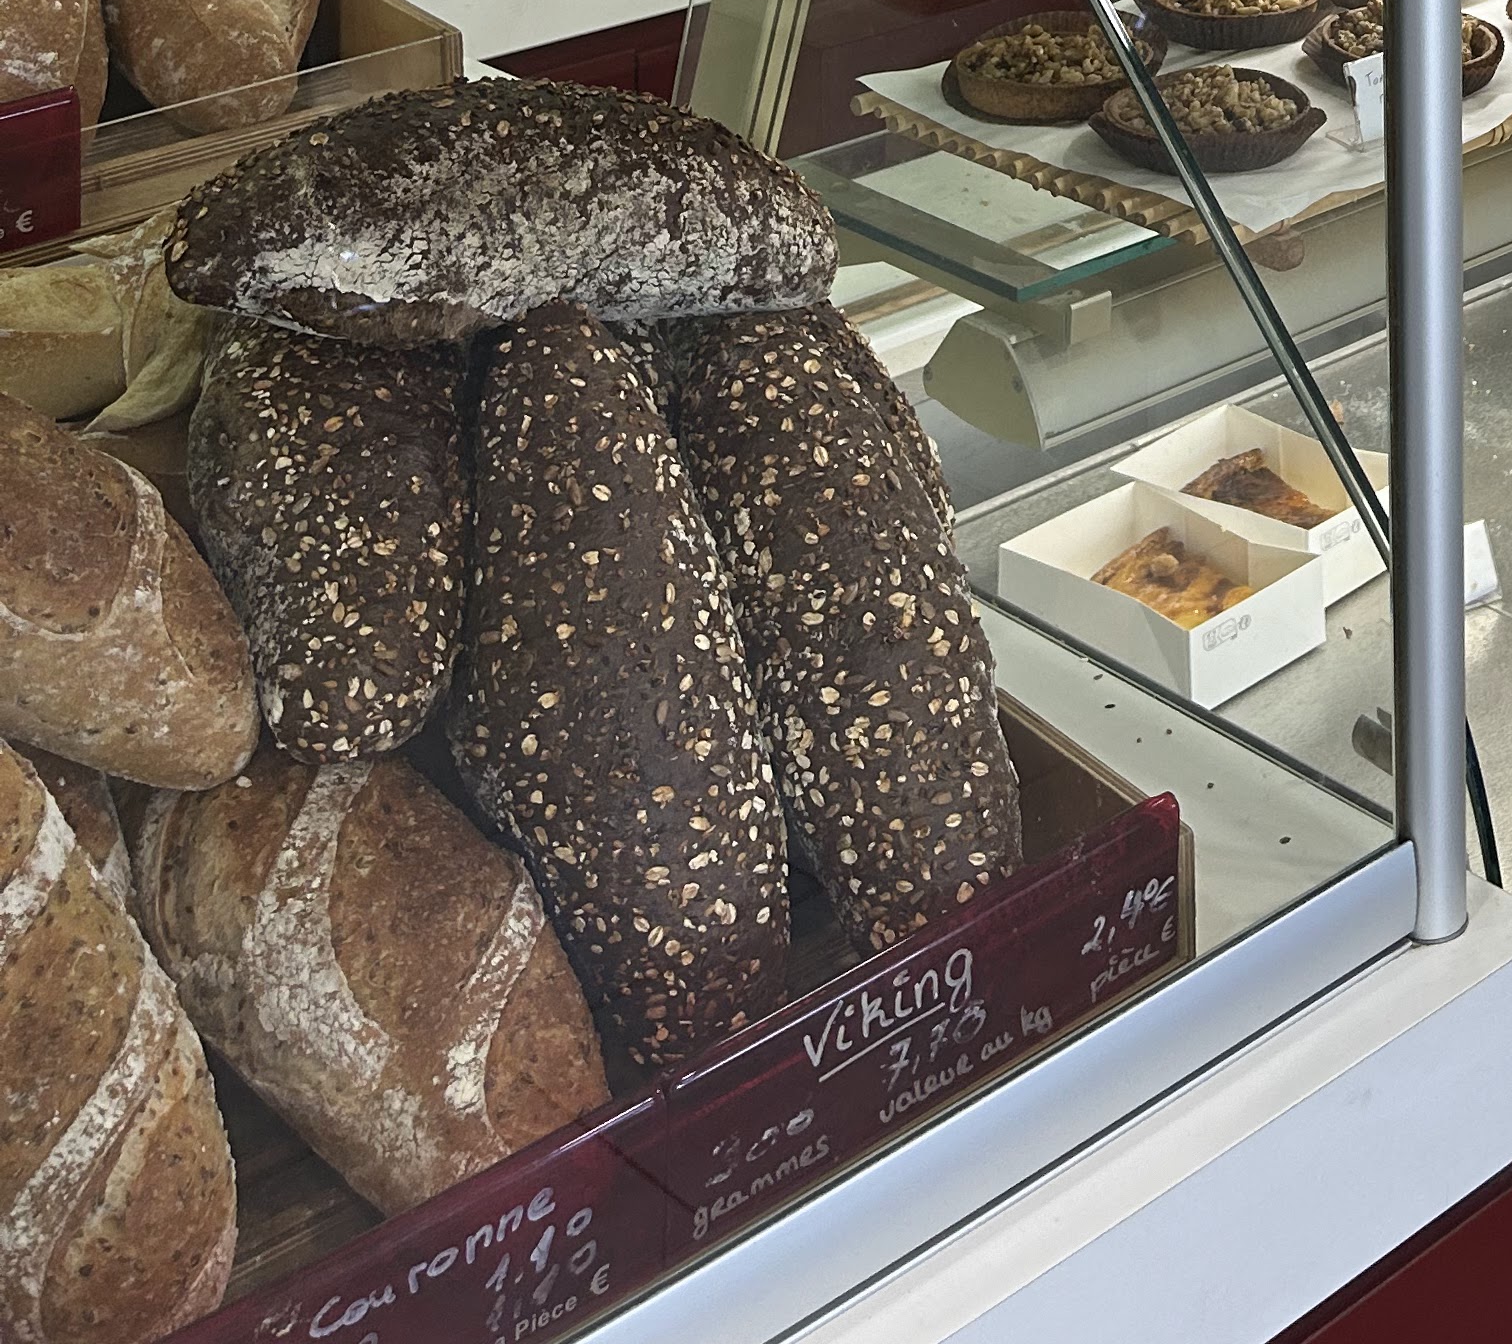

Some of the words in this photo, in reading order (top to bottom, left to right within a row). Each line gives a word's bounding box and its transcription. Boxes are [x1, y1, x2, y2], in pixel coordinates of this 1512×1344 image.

[15, 209, 35, 233] €
[801, 947, 975, 1069] Viking
[980, 1030, 1015, 1062] au
[1020, 1004, 1054, 1037] kg
[692, 1134, 831, 1241] grammes
[514, 1295, 579, 1342] Pièce
[589, 1262, 611, 1296] €
